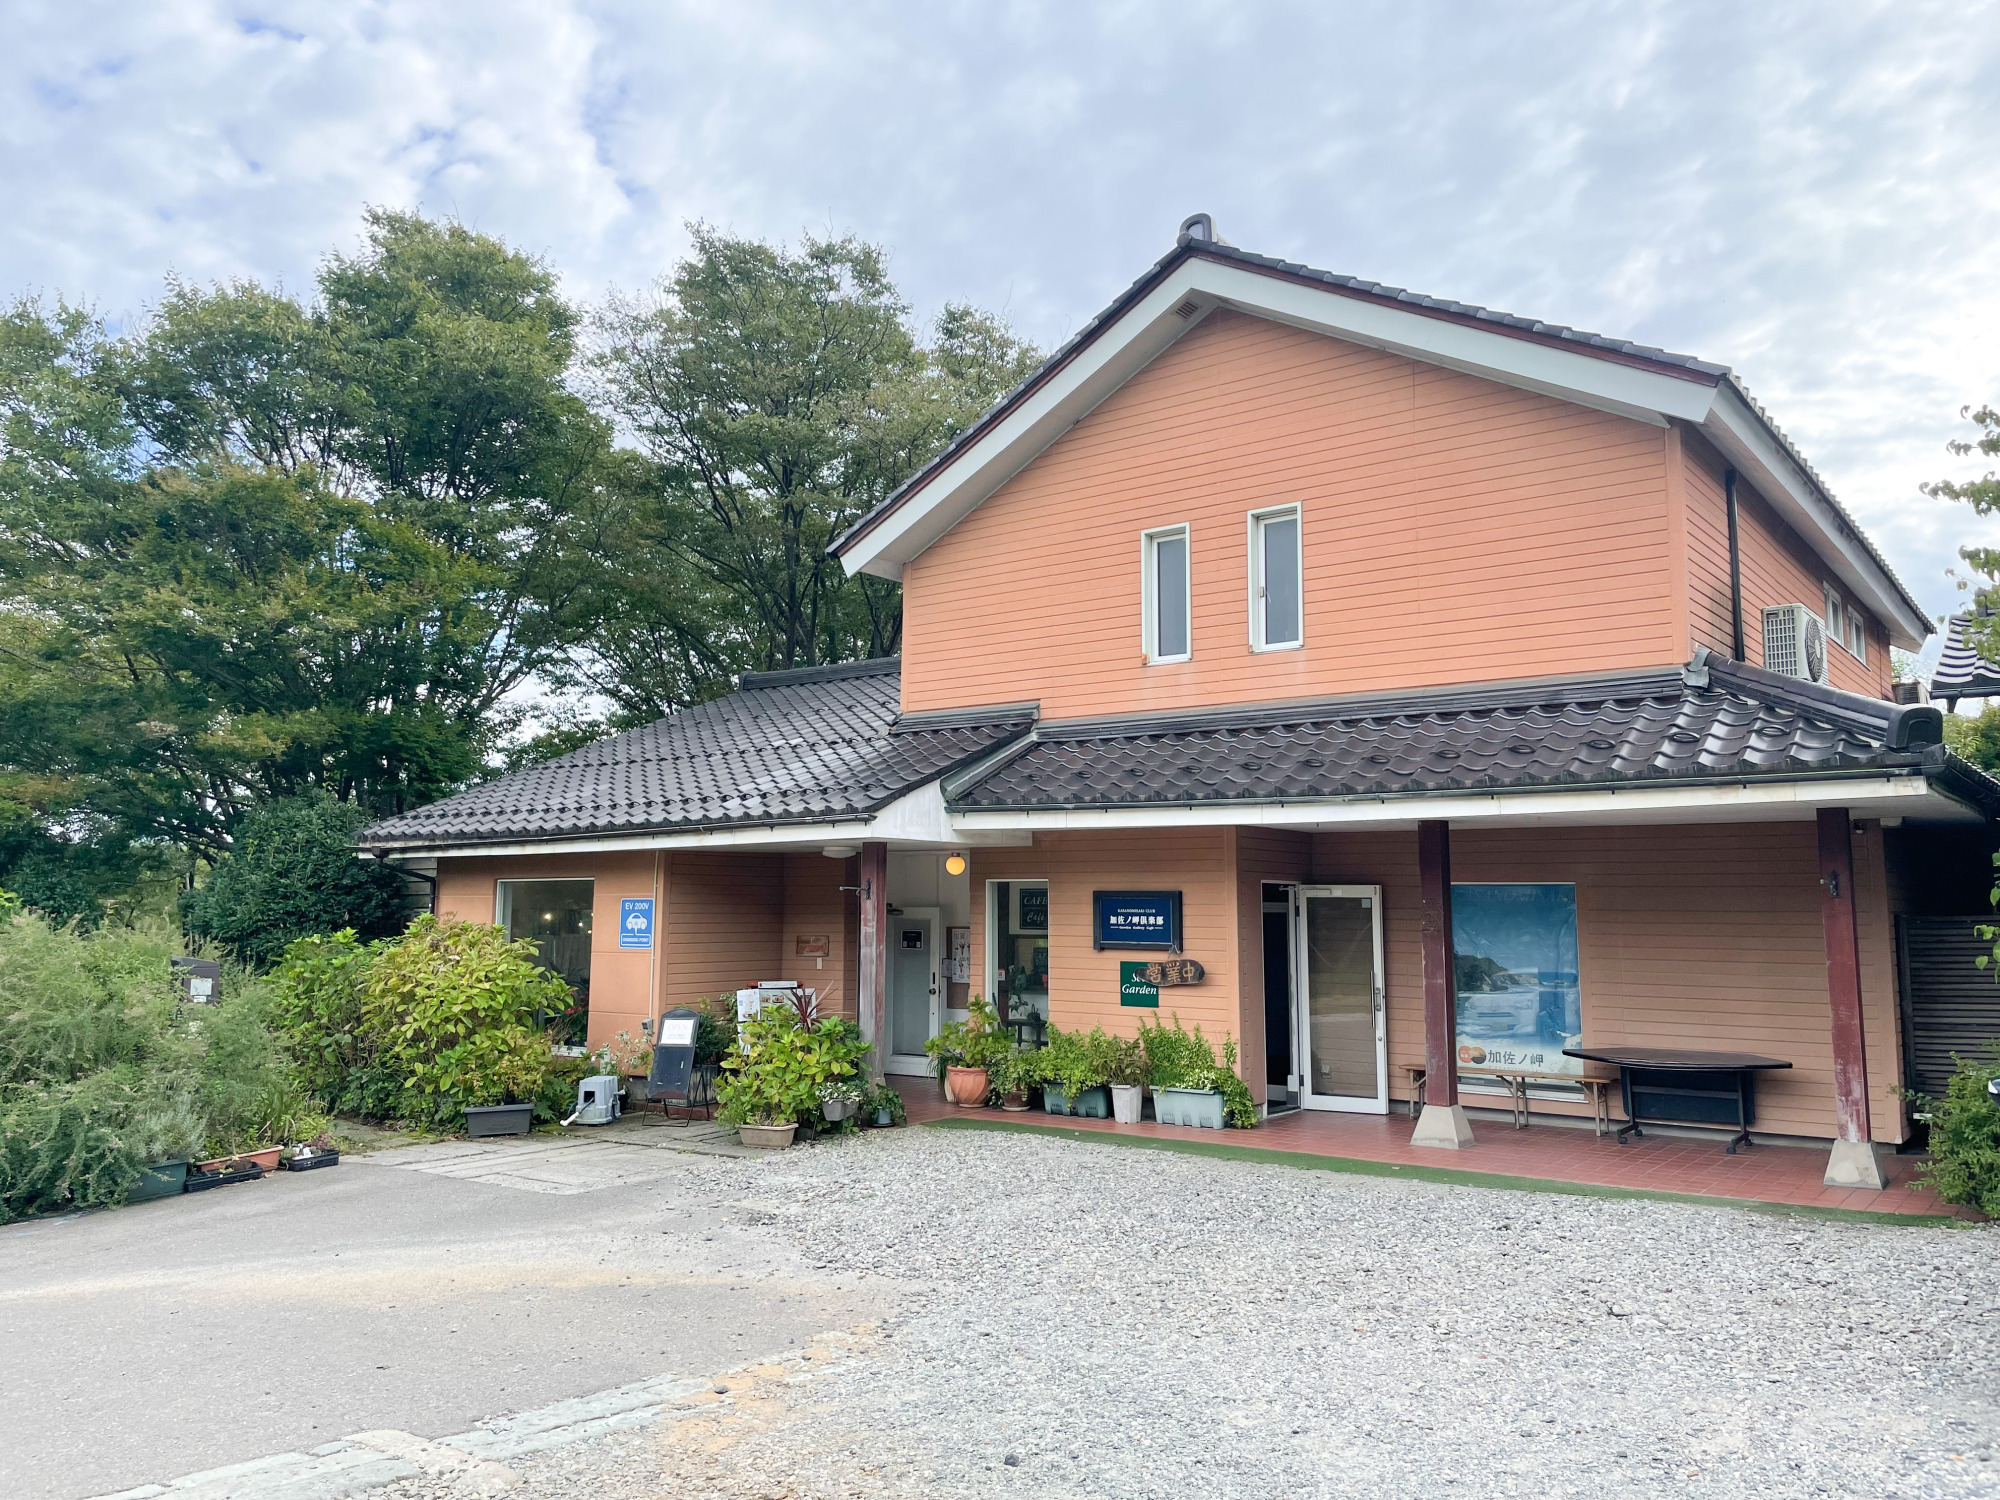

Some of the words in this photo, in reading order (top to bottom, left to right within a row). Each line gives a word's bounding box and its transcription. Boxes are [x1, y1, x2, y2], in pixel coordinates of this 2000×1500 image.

[625, 902, 633, 910] EV
[634, 902, 650, 910] 200V
[1146, 961, 1195, 984] 営業中
[1121, 983, 1157, 995] Garden
[1488, 1049, 1544, 1067] 加佐ノ岬
